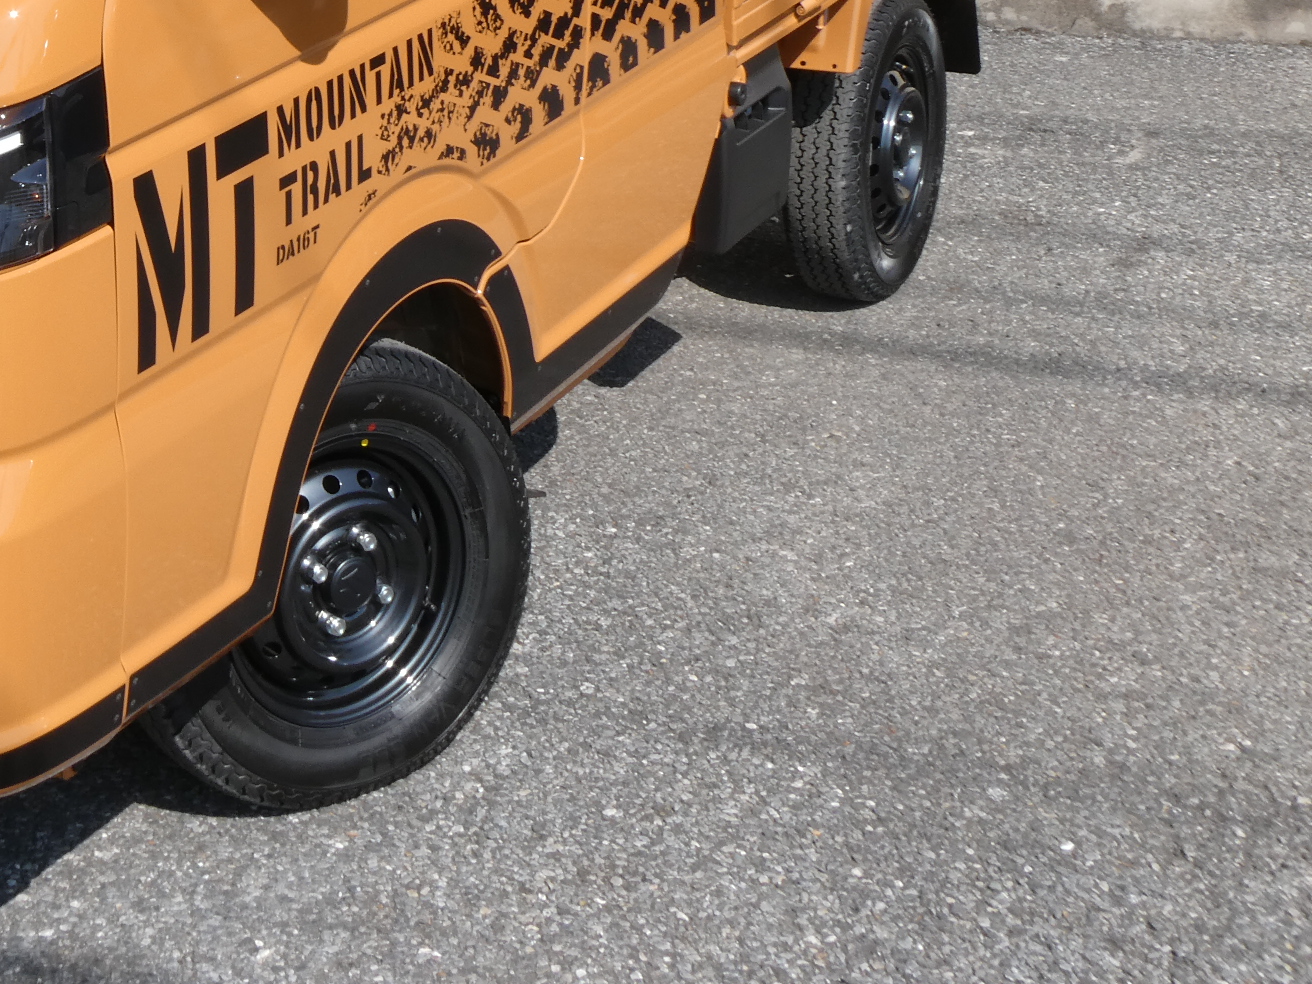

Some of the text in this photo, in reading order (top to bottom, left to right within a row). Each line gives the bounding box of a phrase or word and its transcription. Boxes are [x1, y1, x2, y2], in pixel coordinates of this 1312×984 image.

[275, 27, 435, 159] MOUNTAIN
[278, 133, 372, 227] TRAIL
[132, 111, 270, 375] MT
[276, 225, 320, 266] DA16T
